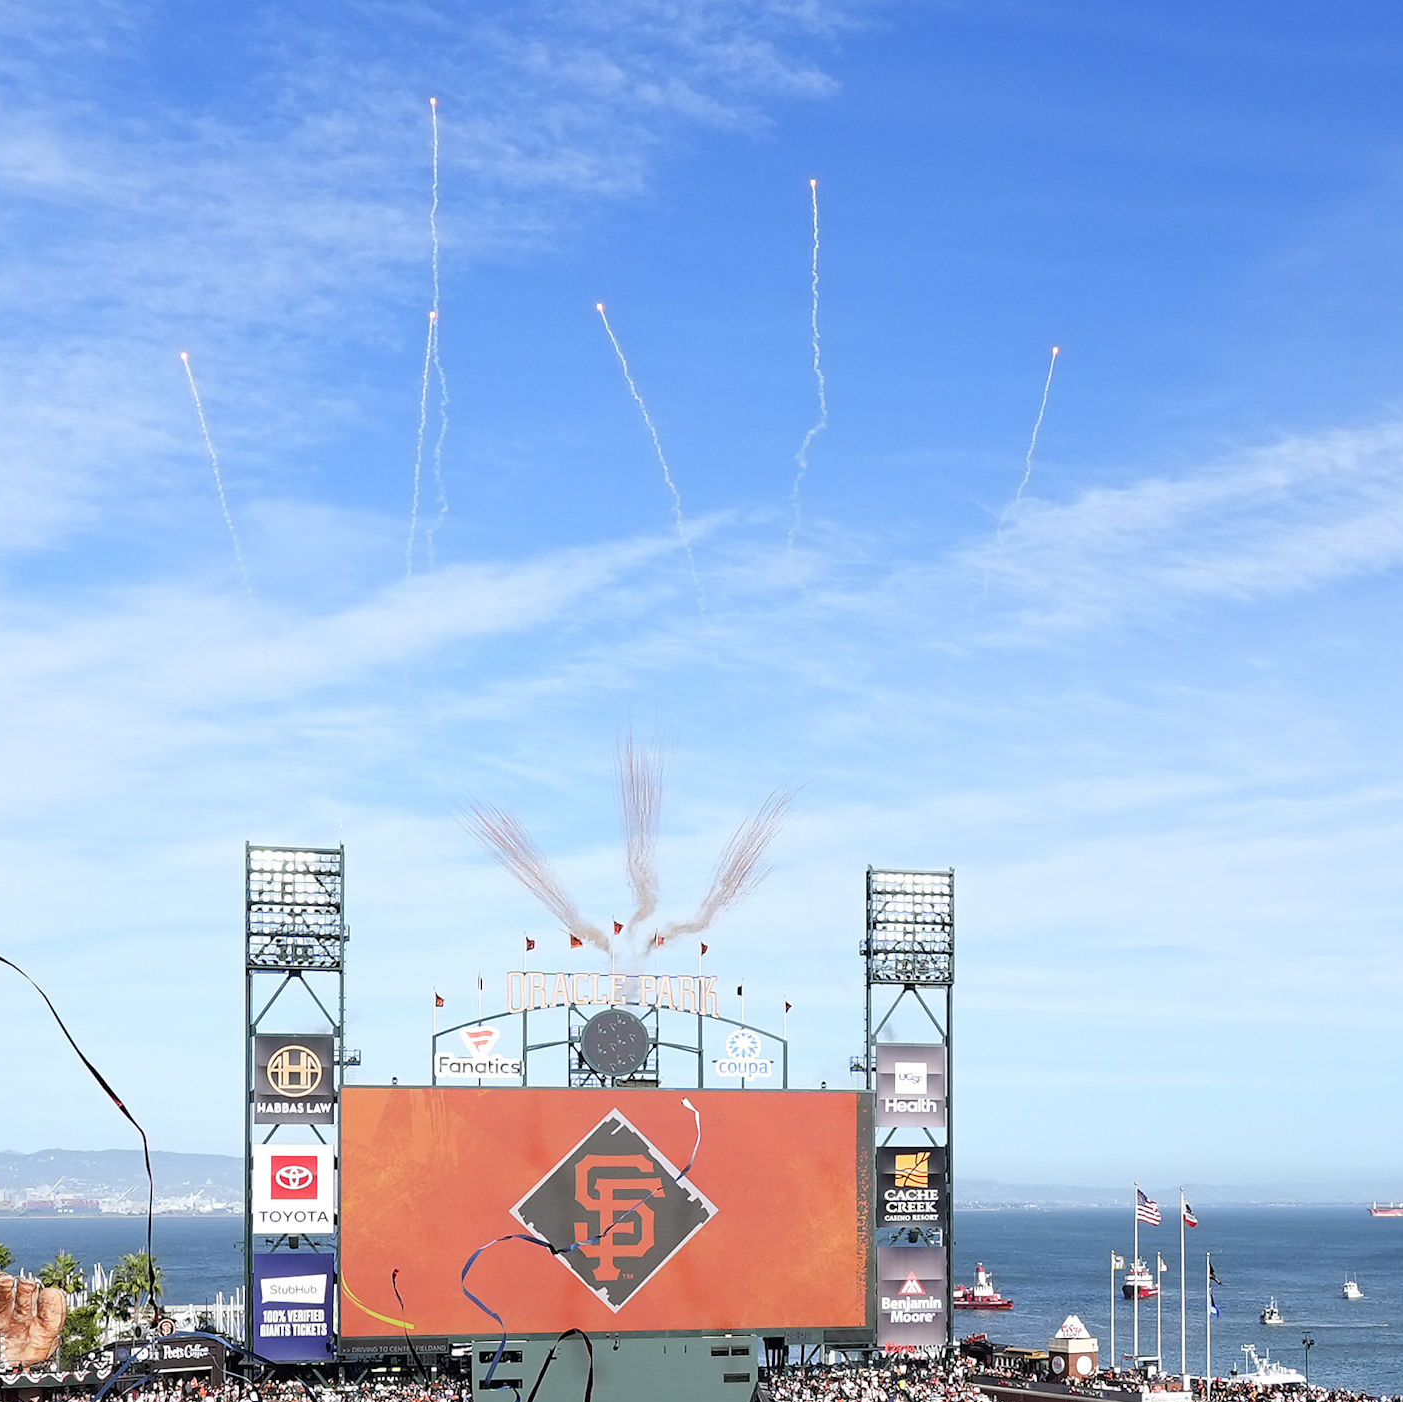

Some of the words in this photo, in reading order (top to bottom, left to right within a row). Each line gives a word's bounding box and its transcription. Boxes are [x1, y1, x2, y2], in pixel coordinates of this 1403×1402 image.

[507, 972, 626, 1013] ORACLE
[640, 975, 720, 1019] PARK
[438, 1056, 521, 1075] Fanatics
[718, 1060, 769, 1077] coupa
[899, 1073, 923, 1085] UCSF
[257, 1102, 304, 1113] HABBAS
[306, 1102, 332, 1113] LAW
[885, 1098, 937, 1113] Health
[884, 1189, 939, 1202] CACHE
[886, 1202, 937, 1213] CREEK
[258, 1211, 329, 1222] TOYOTA
[912, 1214, 939, 1222] RESORT
[270, 1284, 318, 1295] StubHub
[881, 1296, 942, 1311] Benjamin
[263, 1311, 286, 1323] 100%
[287, 1309, 325, 1322] VERIFIED
[260, 1324, 295, 1337] GIANTS
[296, 1323, 328, 1336] TICKETS
[379, 1345, 388, 1353] TO
[389, 1344, 411, 1353] CENTE
